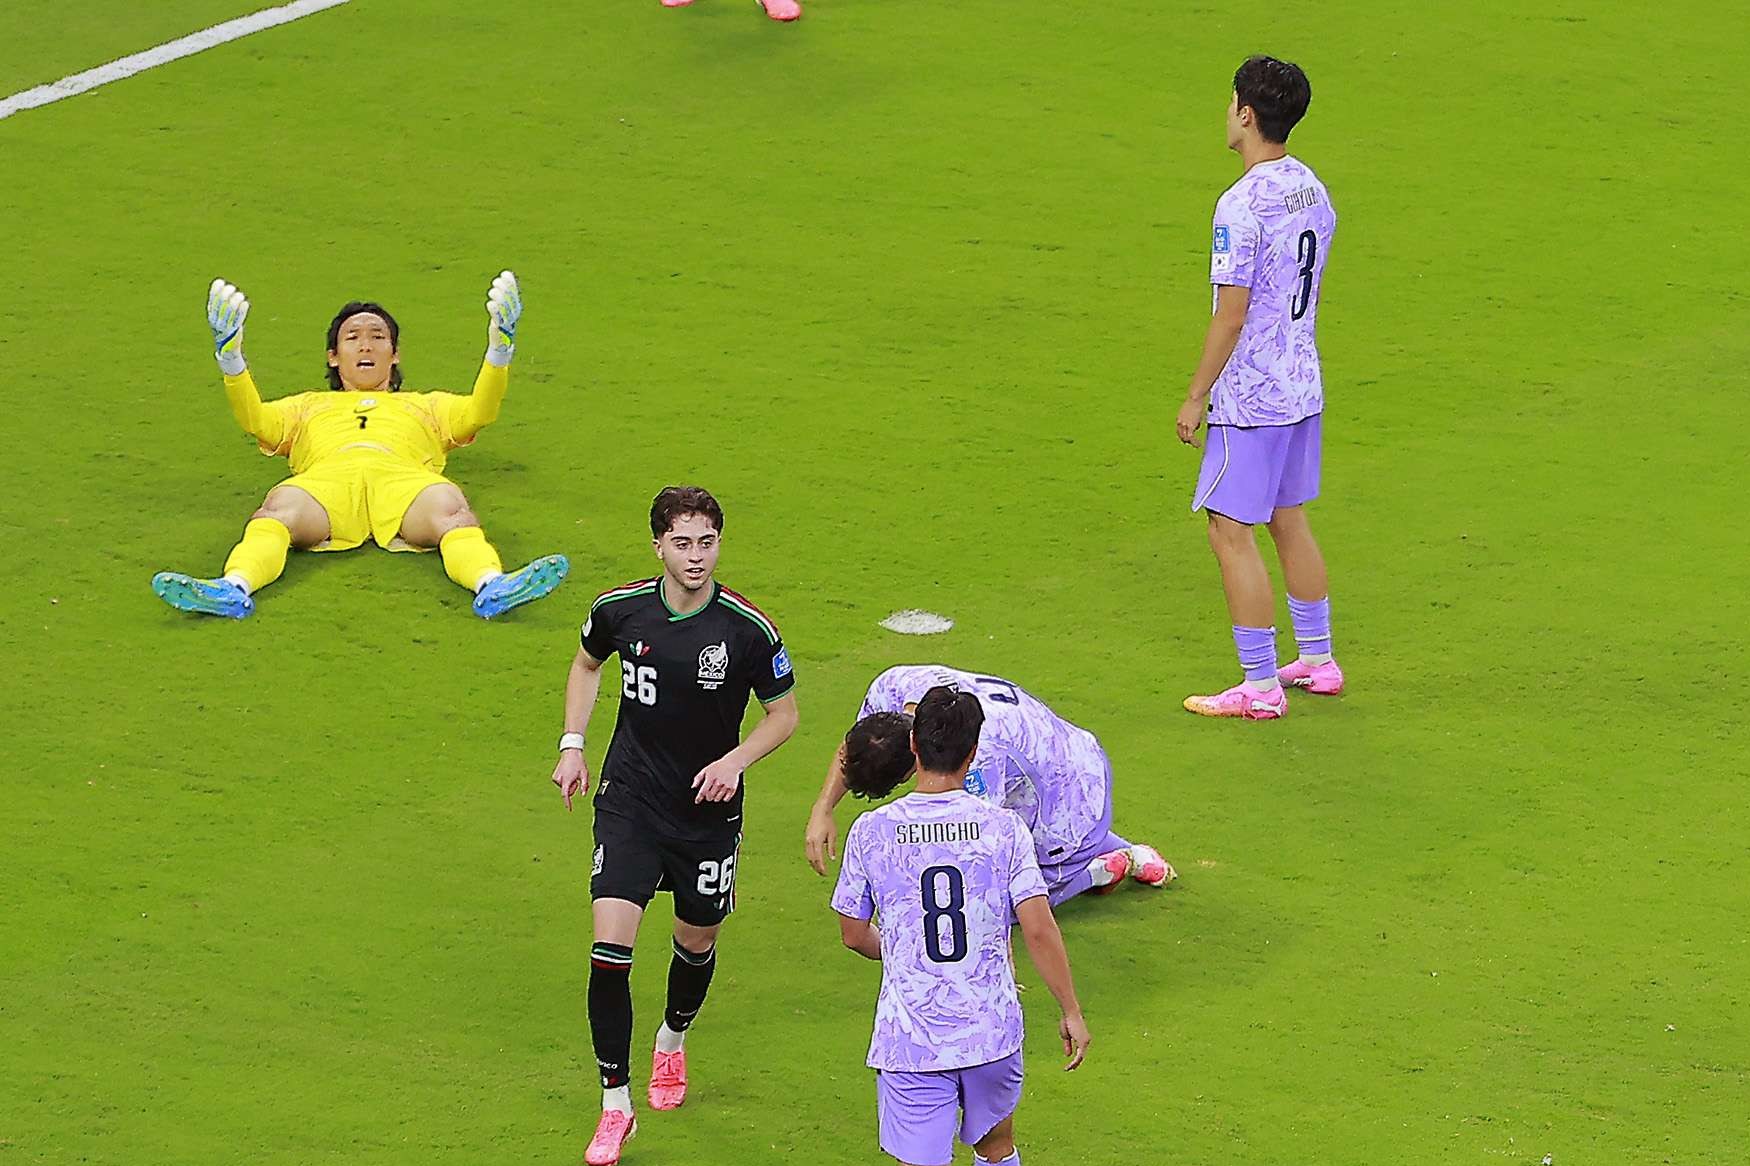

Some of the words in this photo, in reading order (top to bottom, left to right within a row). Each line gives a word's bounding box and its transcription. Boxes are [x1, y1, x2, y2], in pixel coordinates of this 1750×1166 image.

[1291, 229, 1317, 322] 3
[622, 660, 657, 706] 26
[896, 821, 980, 844] SEUNGHO
[697, 856, 734, 896] 26
[920, 864, 969, 963] 8
